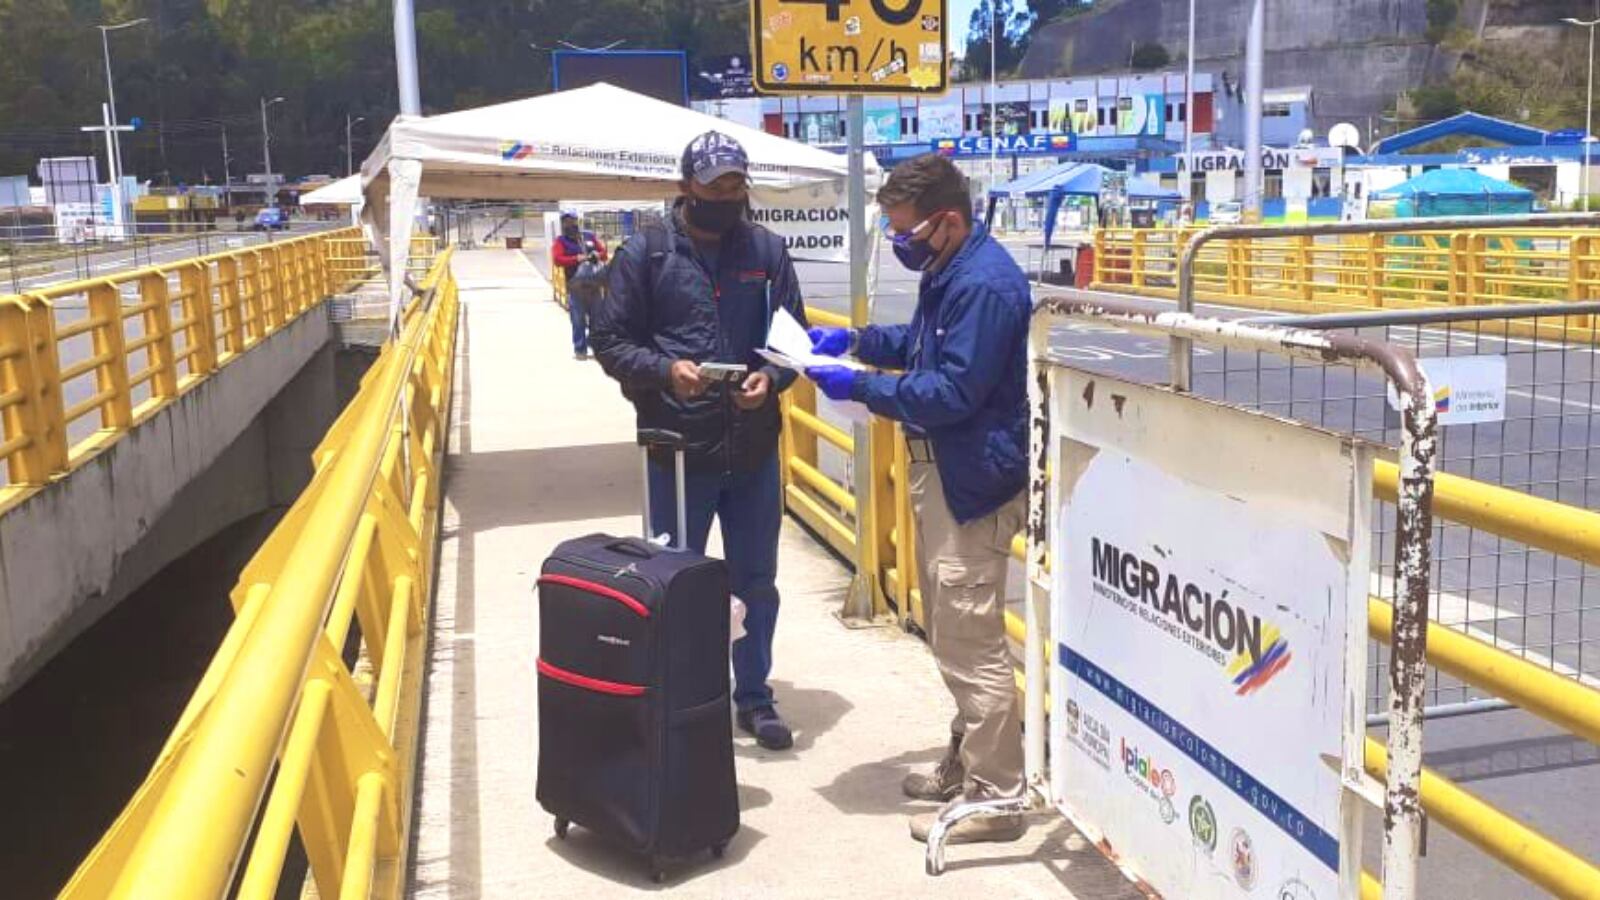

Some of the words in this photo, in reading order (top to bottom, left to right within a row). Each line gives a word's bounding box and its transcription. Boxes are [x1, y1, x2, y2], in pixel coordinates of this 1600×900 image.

[800, 37, 908, 74] km/h
[958, 136, 1046, 151] CENAF
[1177, 150, 1290, 171] MIGRAÓN
[783, 235, 844, 250] UADOR
[1092, 537, 1262, 668] MIGRACIÓN
